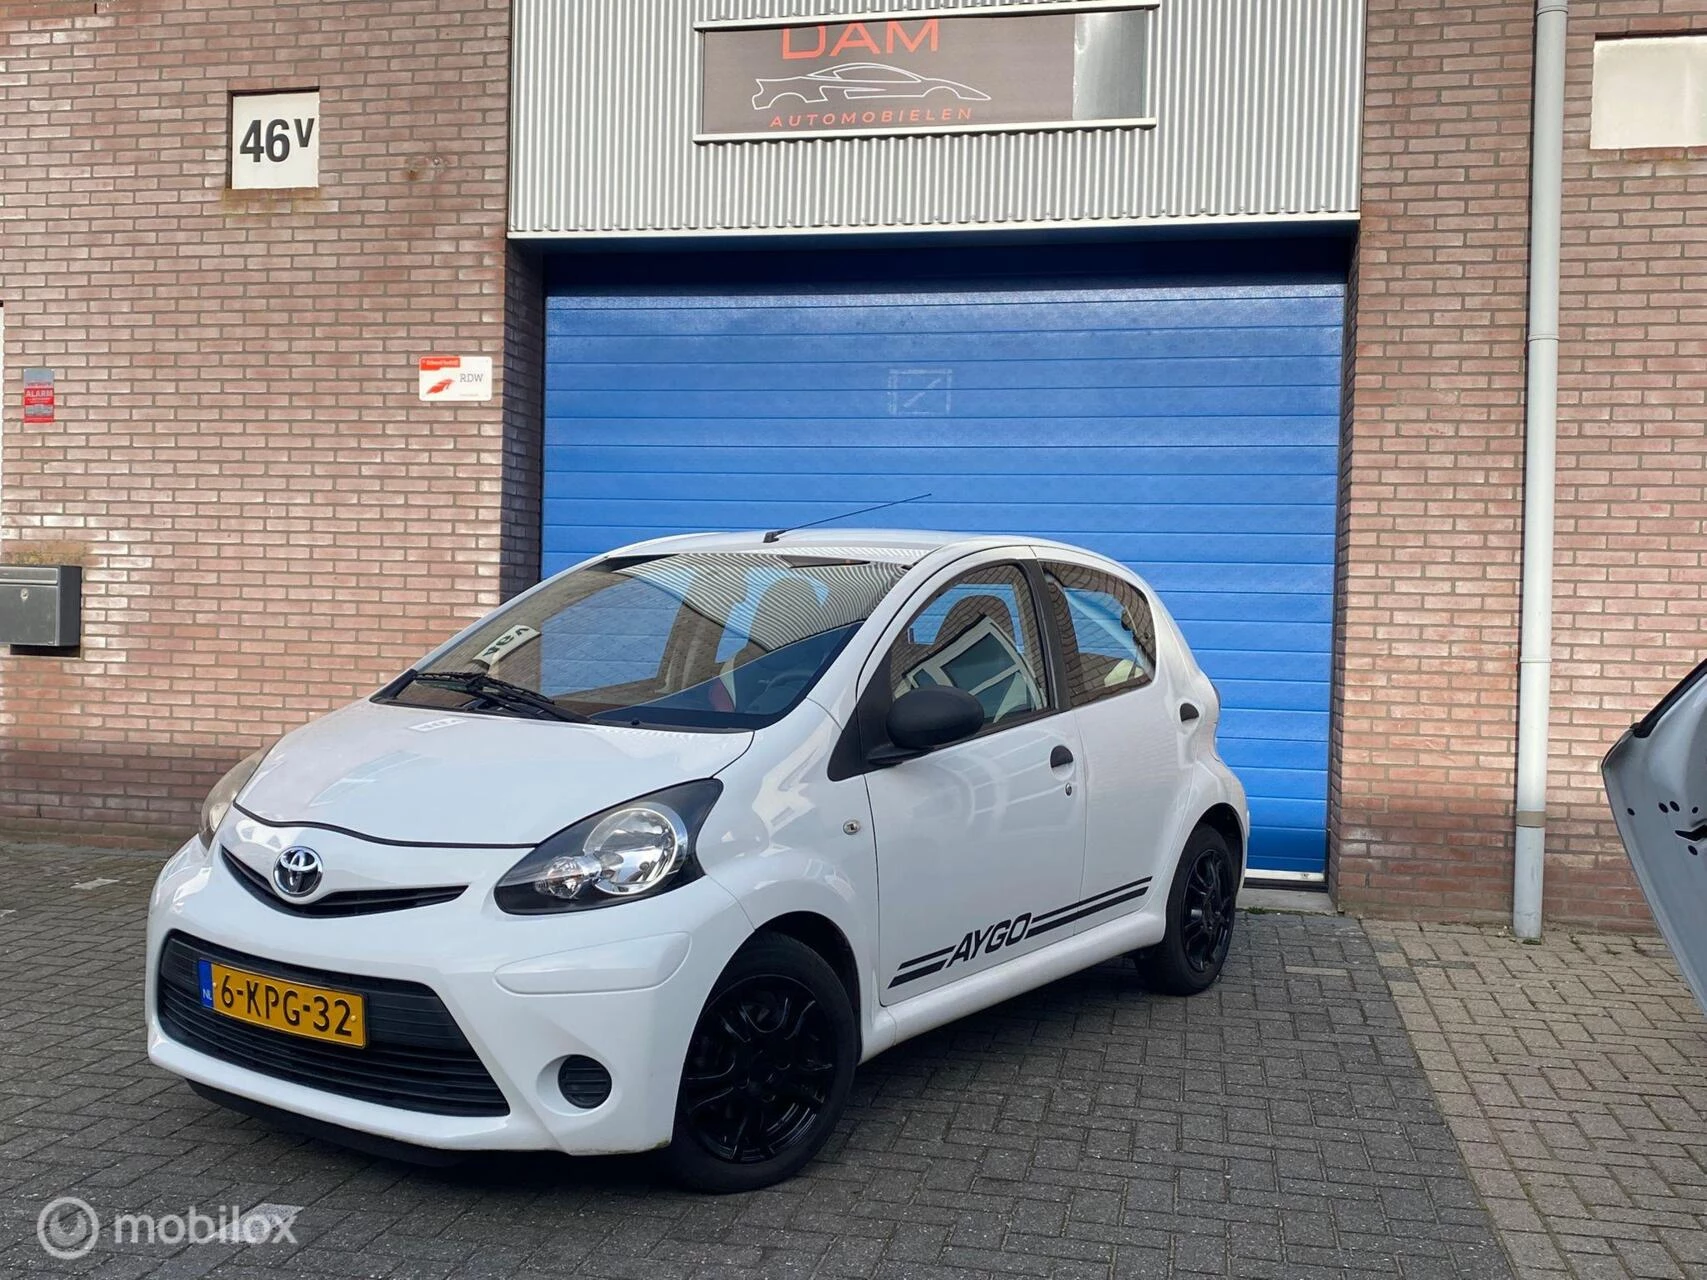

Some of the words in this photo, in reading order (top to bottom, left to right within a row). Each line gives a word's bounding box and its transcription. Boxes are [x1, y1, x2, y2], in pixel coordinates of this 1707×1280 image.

[770, 108, 972, 127] AUTOMOBIELEN
[459, 373, 484, 383] RDW
[25, 390, 53, 398] ALARM
[946, 912, 1032, 969] AYGO
[202, 988, 212, 1001] NL
[221, 975, 353, 1037] 6-KPG-32
